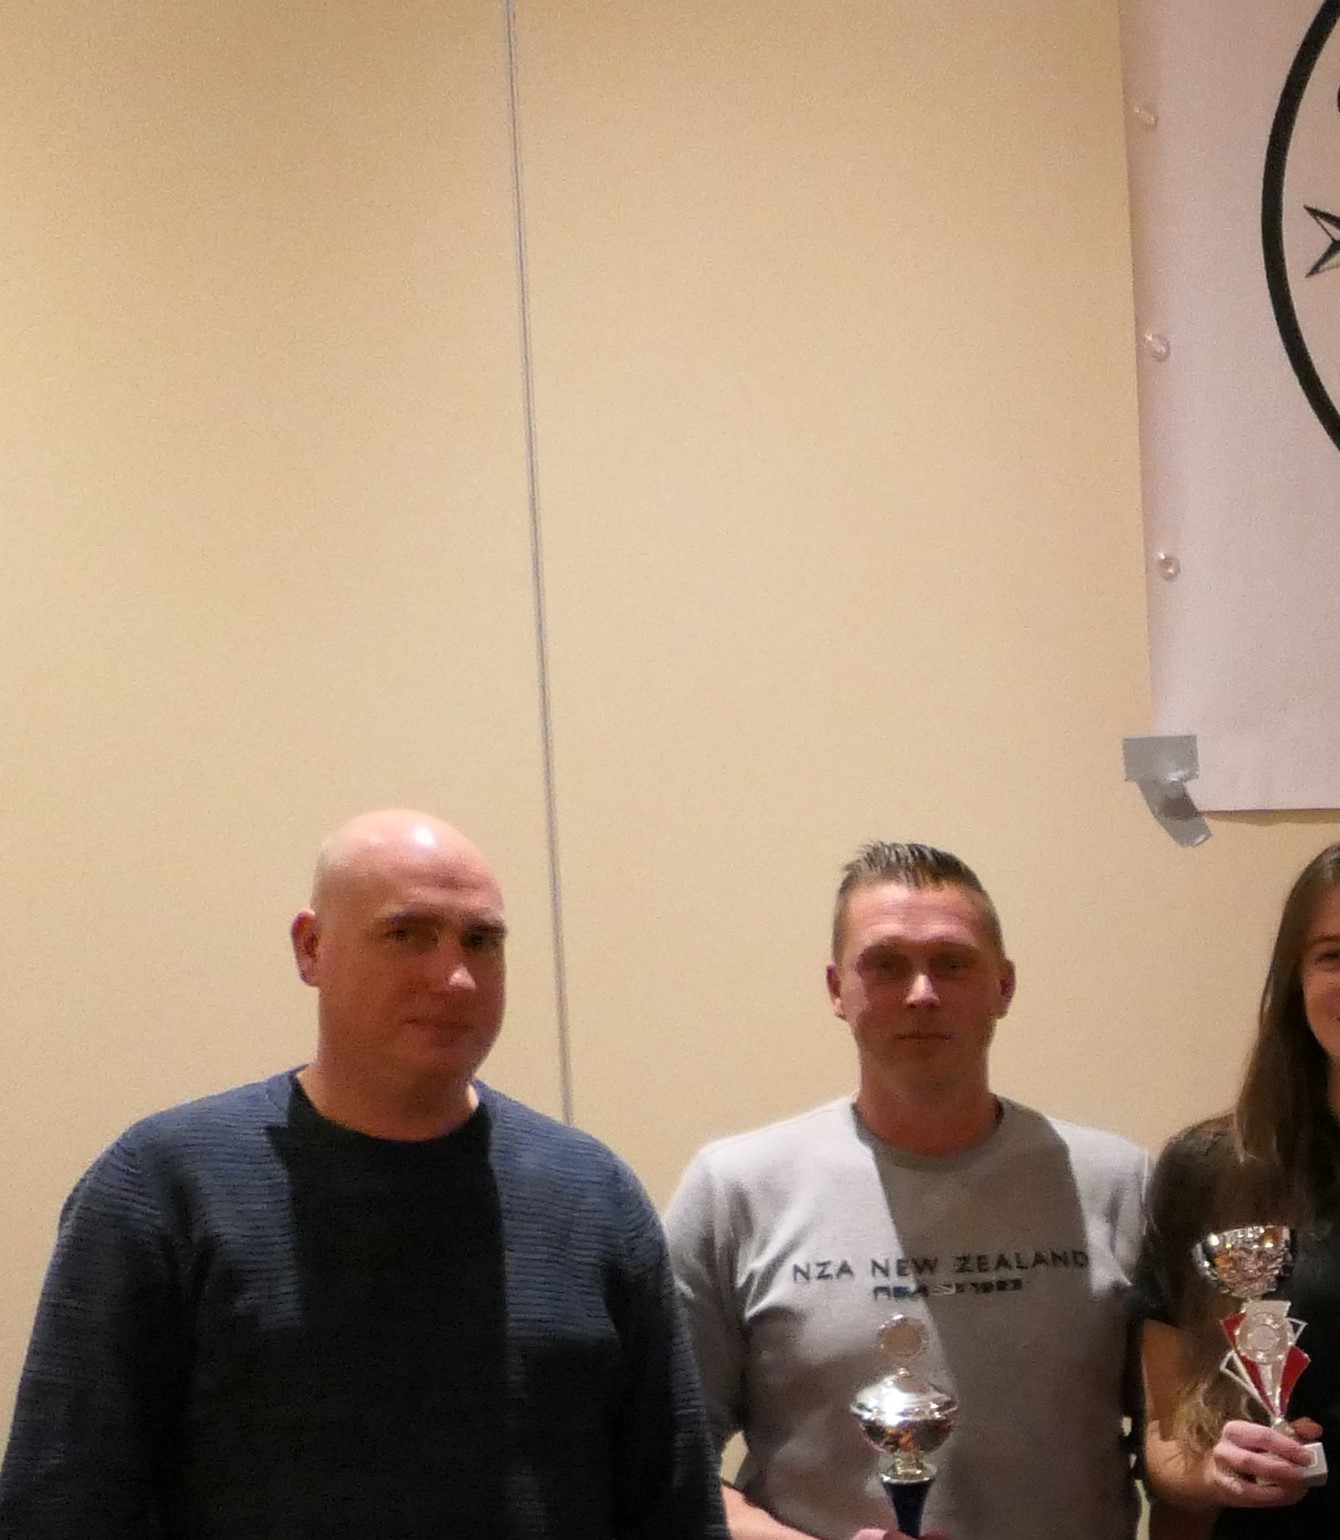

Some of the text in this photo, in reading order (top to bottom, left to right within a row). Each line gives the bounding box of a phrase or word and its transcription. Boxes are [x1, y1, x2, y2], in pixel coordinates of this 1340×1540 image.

[793, 1249, 1090, 1283] NZA NEW ZEALAND
